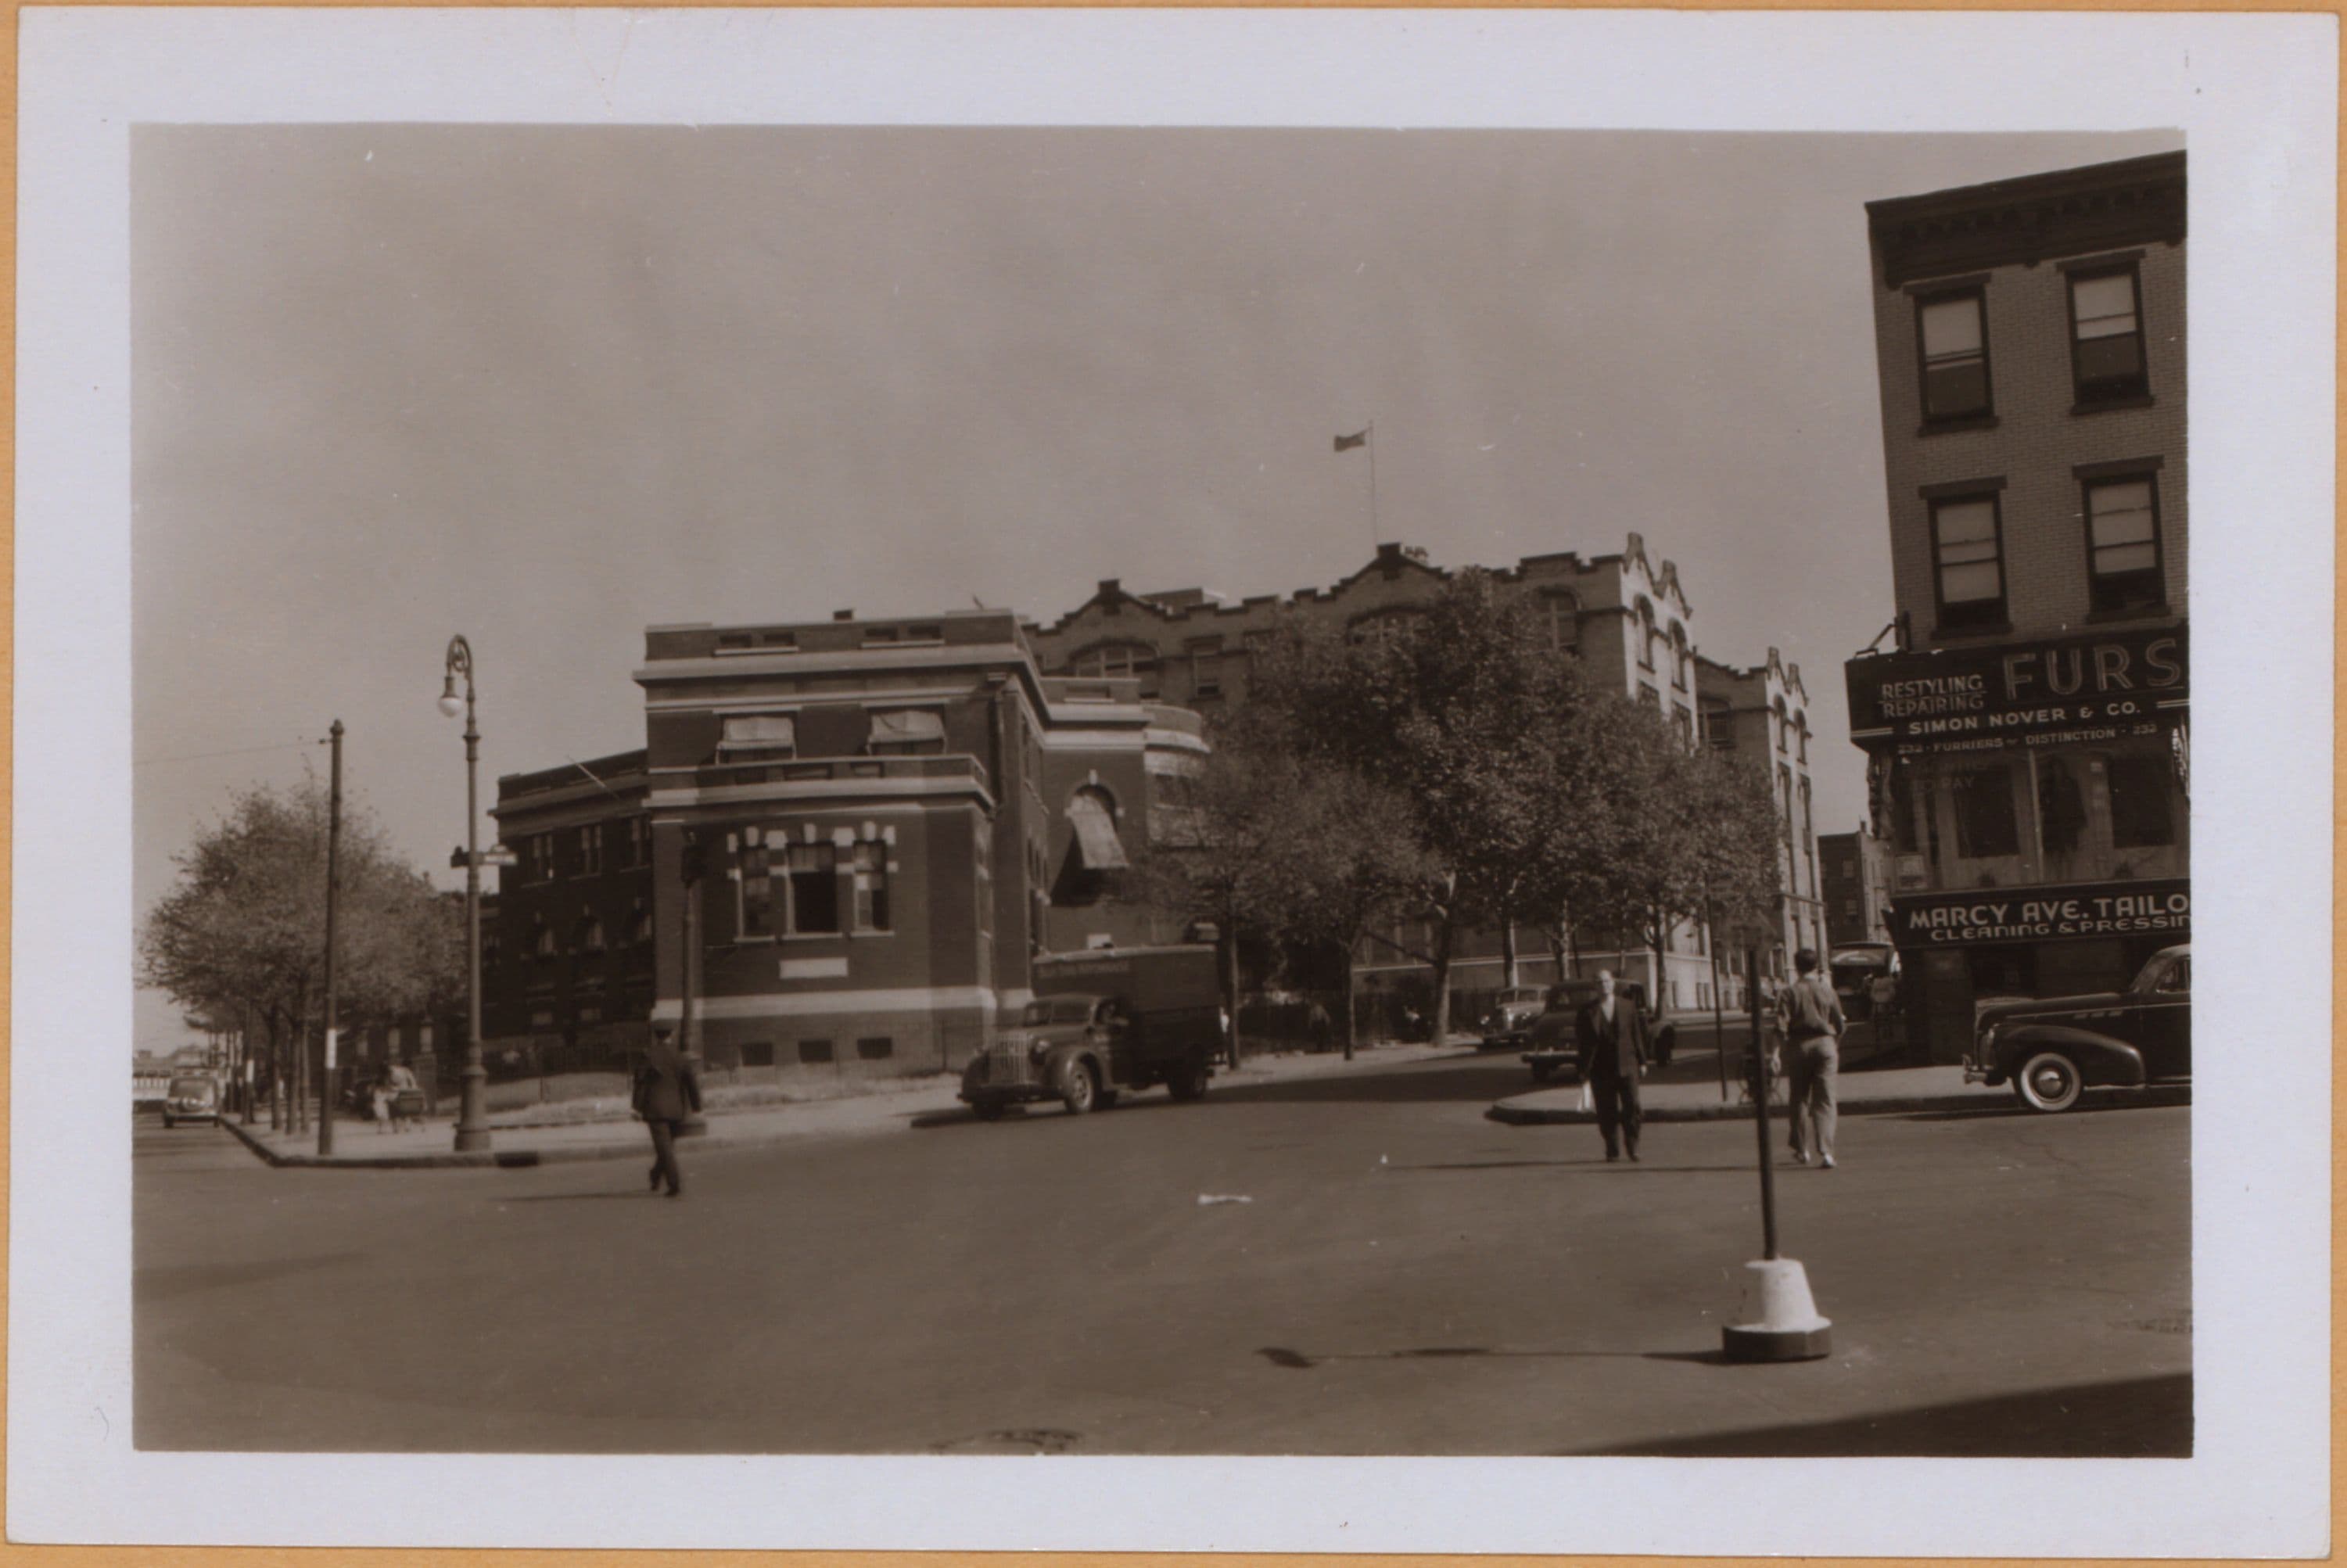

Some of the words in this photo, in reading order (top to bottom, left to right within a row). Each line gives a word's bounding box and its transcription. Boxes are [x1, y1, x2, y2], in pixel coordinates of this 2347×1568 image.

[2003, 637, 2182, 701] FURS
[1882, 674, 1984, 698] RESTYLING
[1882, 694, 1985, 719] REPAIRING
[1909, 716, 1978, 735] SIMON
[1989, 708, 2068, 727] NOVER
[2080, 707, 2094, 719] &
[2107, 701, 2141, 716] CO.
[1933, 737, 2004, 753] FURRIERS
[2025, 728, 2116, 745] DISTINCTION
[1909, 903, 2008, 929] MARCY
[2022, 899, 2090, 923] AVE.
[1930, 924, 2051, 942] CLEANING
